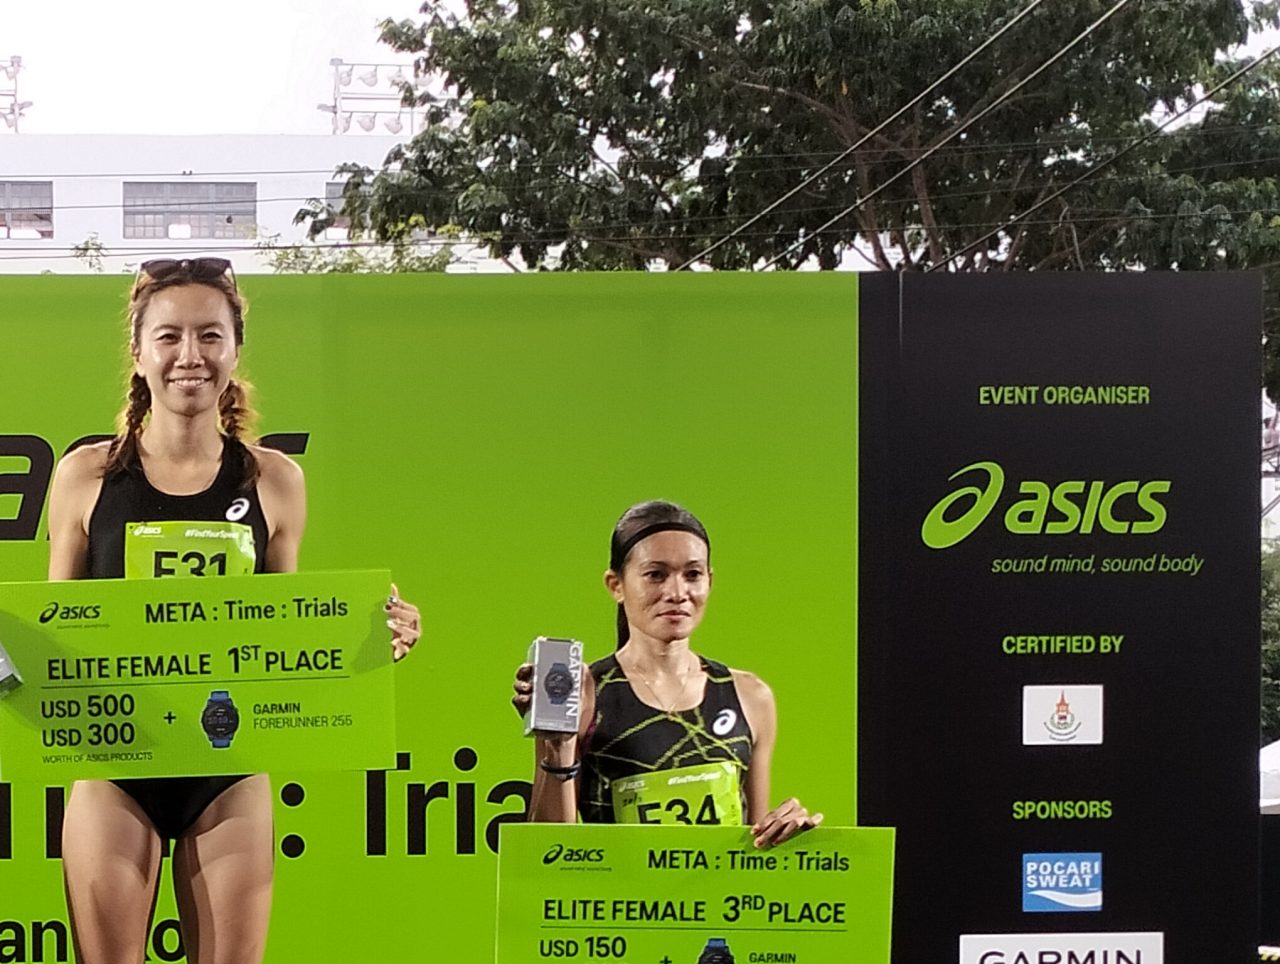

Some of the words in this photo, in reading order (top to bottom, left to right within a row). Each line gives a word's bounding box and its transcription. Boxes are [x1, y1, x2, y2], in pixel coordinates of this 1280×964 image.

[979, 386, 1038, 405] EVENT
[1043, 386, 1150, 405] ORGANISER
[153, 551, 227, 578] F31
[991, 556, 1047, 574] sound
[1050, 555, 1096, 576] mind,
[1100, 555, 1156, 573] sound
[1159, 554, 1204, 576] body
[145, 602, 206, 624] META
[224, 600, 275, 621] Time
[292, 597, 348, 618] Trials
[1002, 637, 1095, 655] CERTIFIED
[1100, 636, 1124, 654] BY
[47, 657, 110, 681] ELITE
[116, 654, 211, 678] FEMALE
[265, 649, 343, 672] PLACE
[41, 700, 81, 719] USD
[87, 693, 135, 718] 500
[252, 702, 301, 715] GARMIN
[253, 716, 329, 730] FORERUNNER
[331, 715, 353, 727] 255
[42, 729, 82, 748] USD
[87, 722, 135, 746] 300
[42, 754, 72, 764] WORTH
[110, 752, 152, 762] PRODUCTS
[366, 747, 534, 857] Tria
[637, 794, 722, 825] F34
[1012, 801, 1113, 819] SPONSORS
[647, 850, 709, 870] META
[726, 850, 777, 871] Time
[795, 850, 850, 872] Trials
[1026, 861, 1100, 875] POCARI
[1026, 875, 1093, 888] SWEAT
[543, 899, 606, 921] ELITE
[611, 899, 706, 922] FEMALE
[767, 902, 846, 924] PLACE
[539, 939, 579, 958] USD
[584, 936, 627, 958] 150
[748, 952, 796, 964] GARMIN
